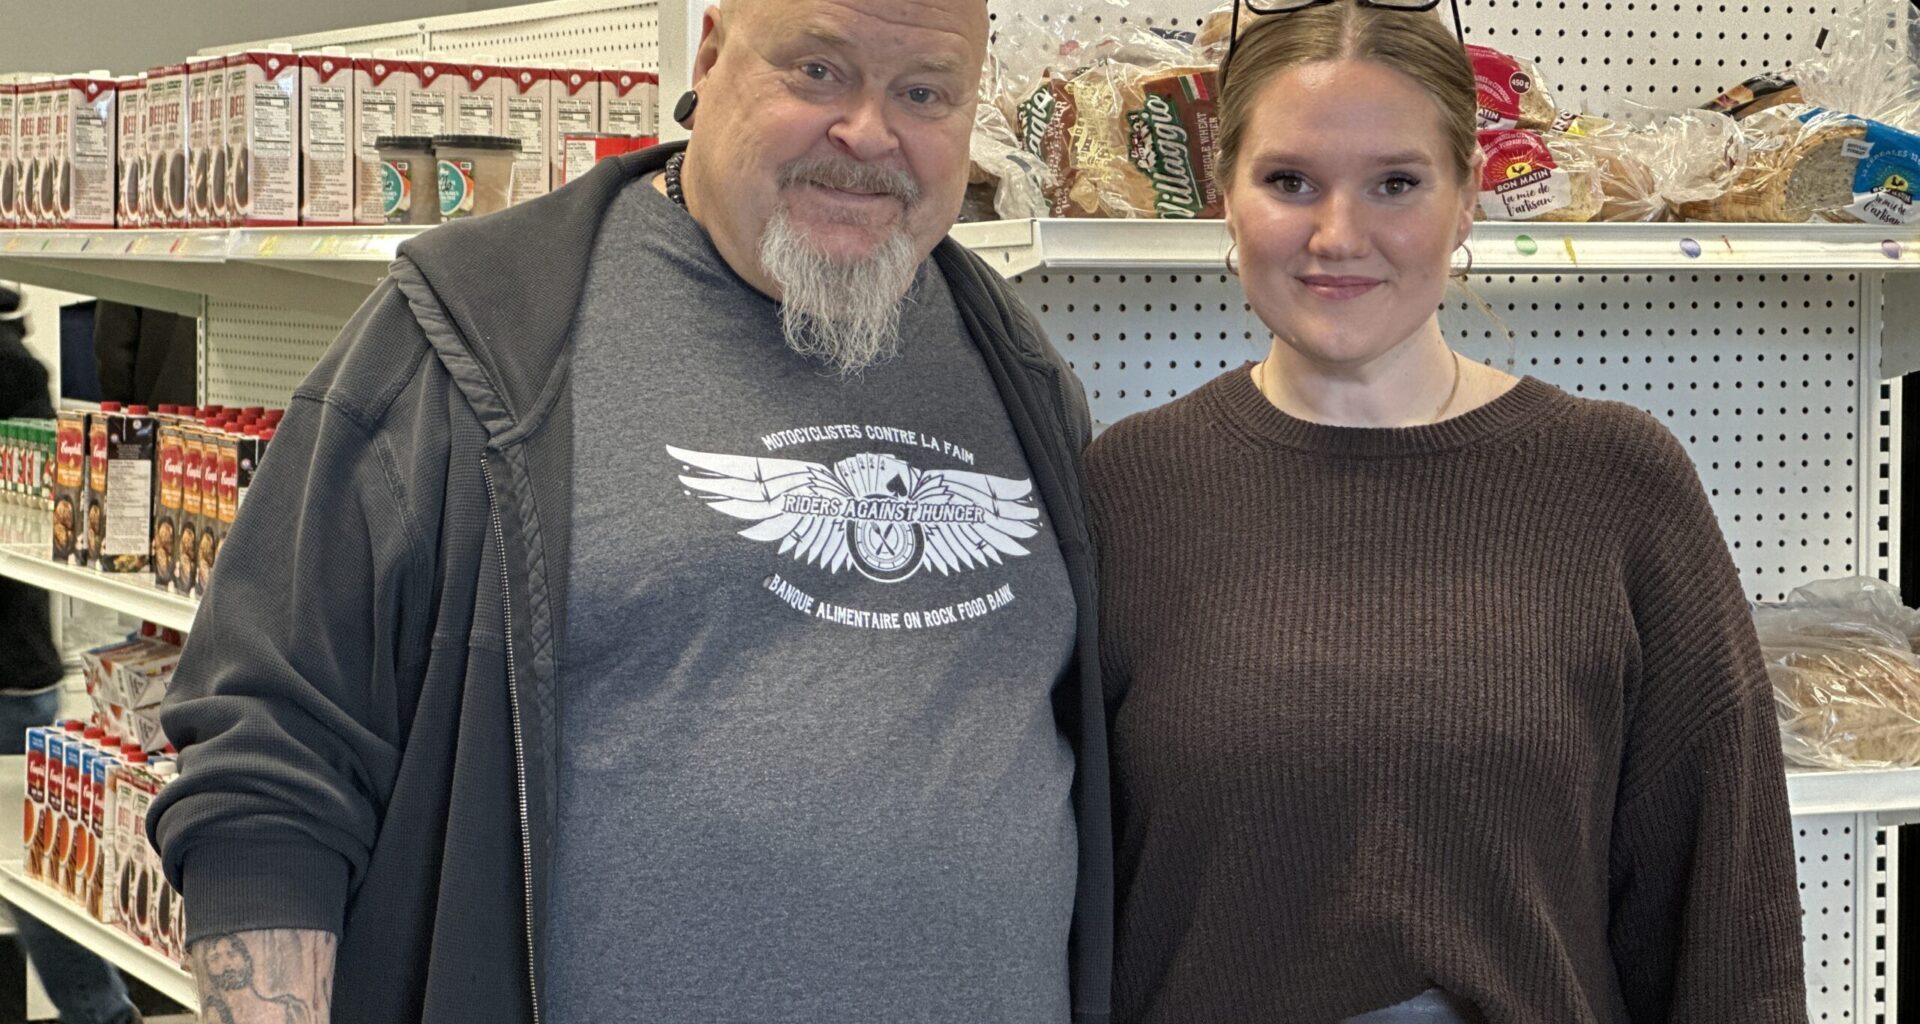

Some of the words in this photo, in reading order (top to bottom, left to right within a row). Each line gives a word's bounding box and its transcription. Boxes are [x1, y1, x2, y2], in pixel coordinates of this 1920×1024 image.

[1511, 78, 1524, 87] 450
[1147, 94, 1195, 219] Villaggio
[1497, 181, 1518, 192] BON
[1520, 169, 1549, 185] MATIN
[1517, 189, 1536, 200] mie
[1538, 183, 1550, 194] de
[761, 424, 862, 451] MOTOCYCLISTES
[865, 425, 918, 446] CONTRE
[921, 433, 940, 452] LA
[944, 440, 974, 465] FAIM
[784, 494, 841, 517] RIDERS
[842, 498, 919, 521] AGAINST
[920, 503, 985, 523] HUNGER
[768, 573, 815, 614] BANQUE
[816, 602, 900, 629] ALIMENTAIRE
[903, 610, 922, 629] ON
[923, 606, 957, 628] ROCK
[957, 597, 987, 620] FOOD
[986, 583, 1015, 611] BANK
